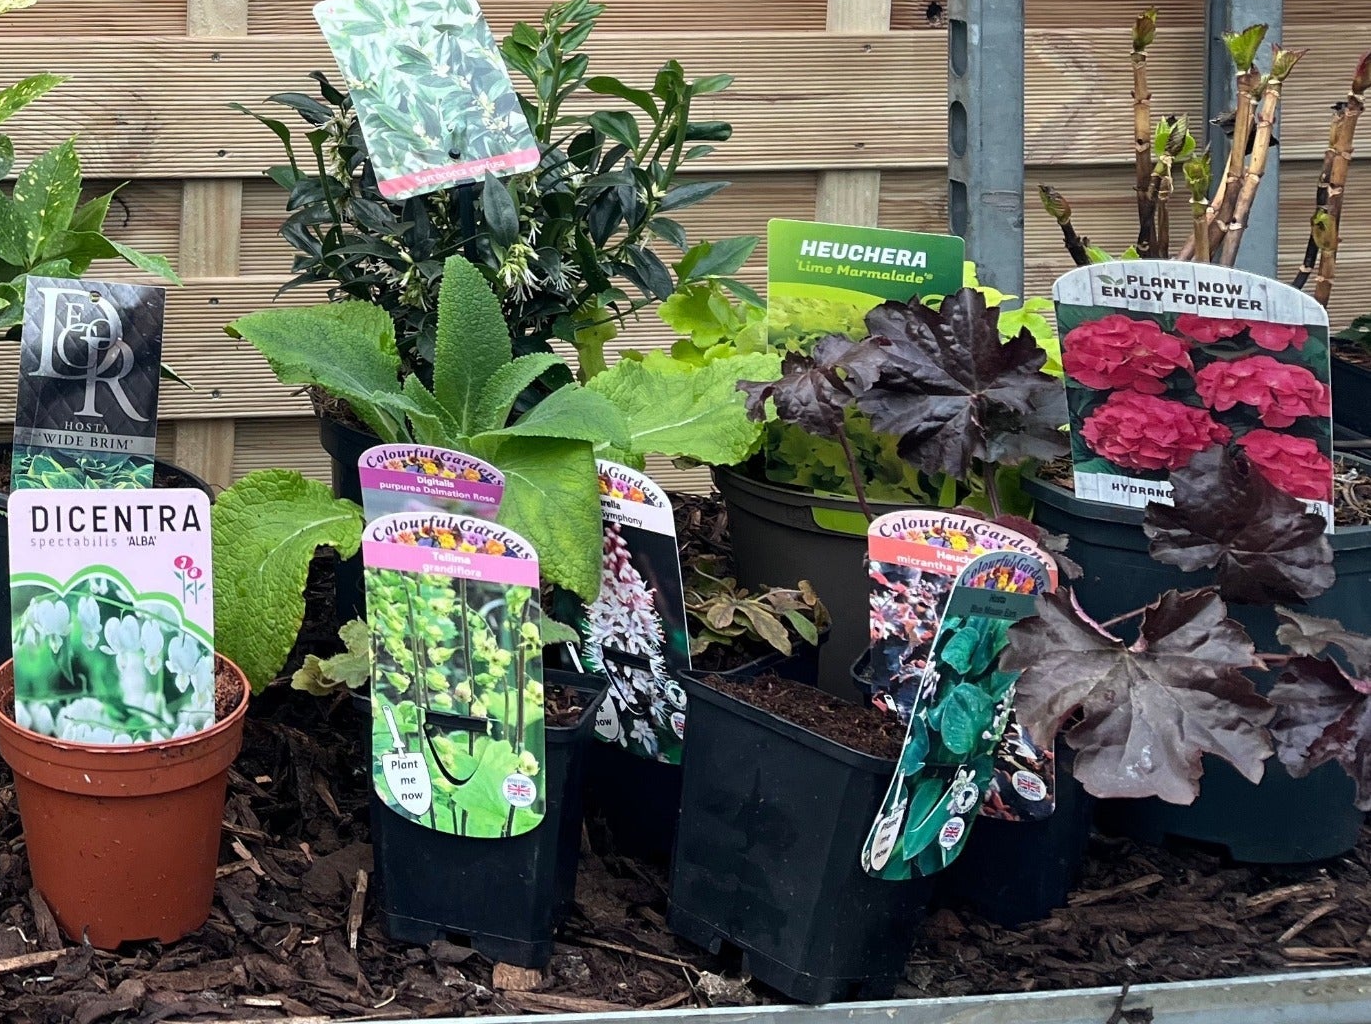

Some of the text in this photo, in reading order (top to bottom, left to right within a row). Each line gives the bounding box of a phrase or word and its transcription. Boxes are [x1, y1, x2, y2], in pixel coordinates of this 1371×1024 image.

[800, 239, 927, 268] HEUCHERA
[1127, 275, 1243, 295] PLANT NOW
[1102, 286, 1263, 311] ENJOY FOREVER
[64, 421, 109, 433] HOSTA
[91, 437, 134, 450] BRIM'
[366, 448, 504, 486] Colourful Gardens
[416, 476, 455, 489] Digitalis
[608, 466, 665, 508] Gardens
[379, 481, 496, 503] purpurea Dalmation Rose
[1112, 483, 1173, 498] HYDRANG
[31, 504, 202, 533] DICENTRA
[30, 535, 118, 549] spectabilis
[373, 515, 532, 560] Colourful Gardens
[879, 516, 1051, 569] Colourful Gardens
[431, 551, 471, 564] Tellima
[897, 556, 953, 572] micrantha
[937, 551, 973, 564] Heuch
[422, 562, 482, 577] grandiflora
[962, 555, 1045, 589] Colourful Garden
[391, 760, 418, 770] Plant
[401, 777, 416, 785] me
[401, 792, 423, 801] now
